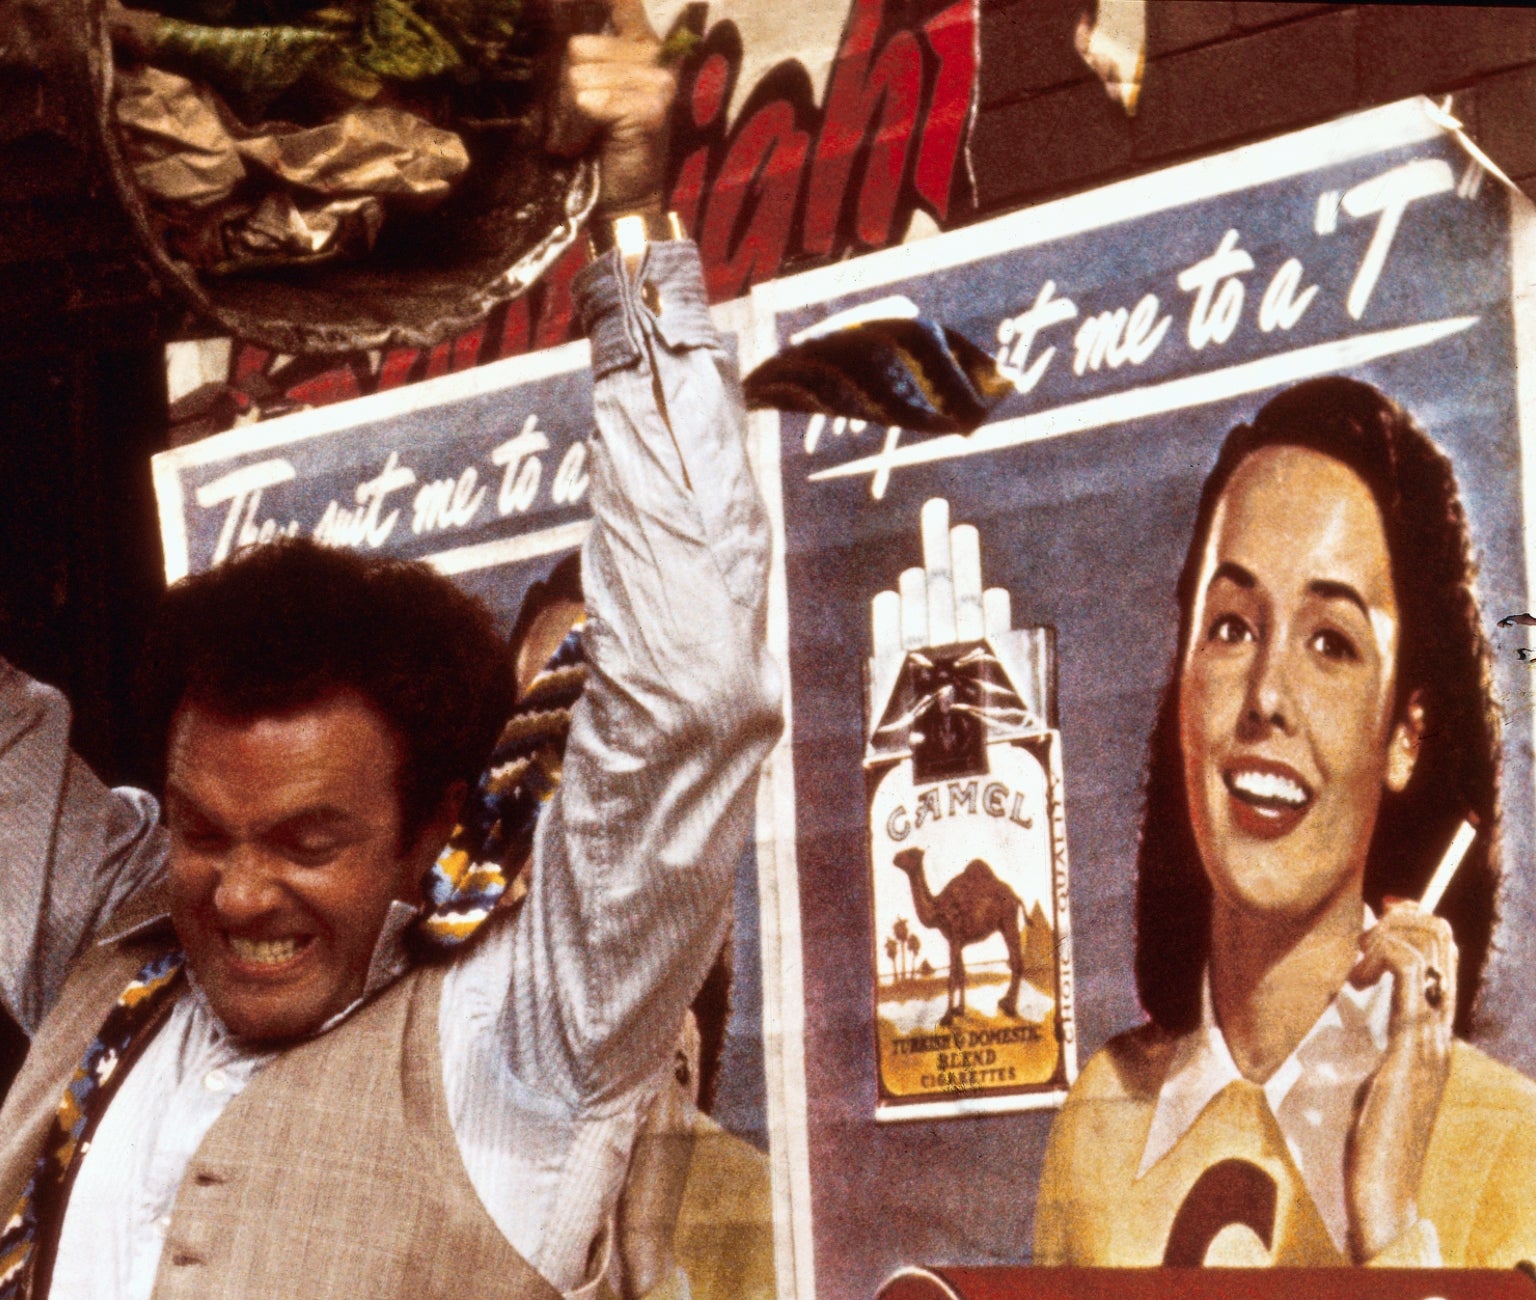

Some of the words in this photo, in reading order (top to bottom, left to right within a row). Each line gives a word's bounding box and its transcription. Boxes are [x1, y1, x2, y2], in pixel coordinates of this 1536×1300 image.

[1074, 293, 1172, 376] me
[1178, 228, 1254, 350] to
[1259, 257, 1320, 333] a
[413, 466, 488, 535] me
[491, 413, 551, 516] to
[886, 781, 1033, 842] CAMEL
